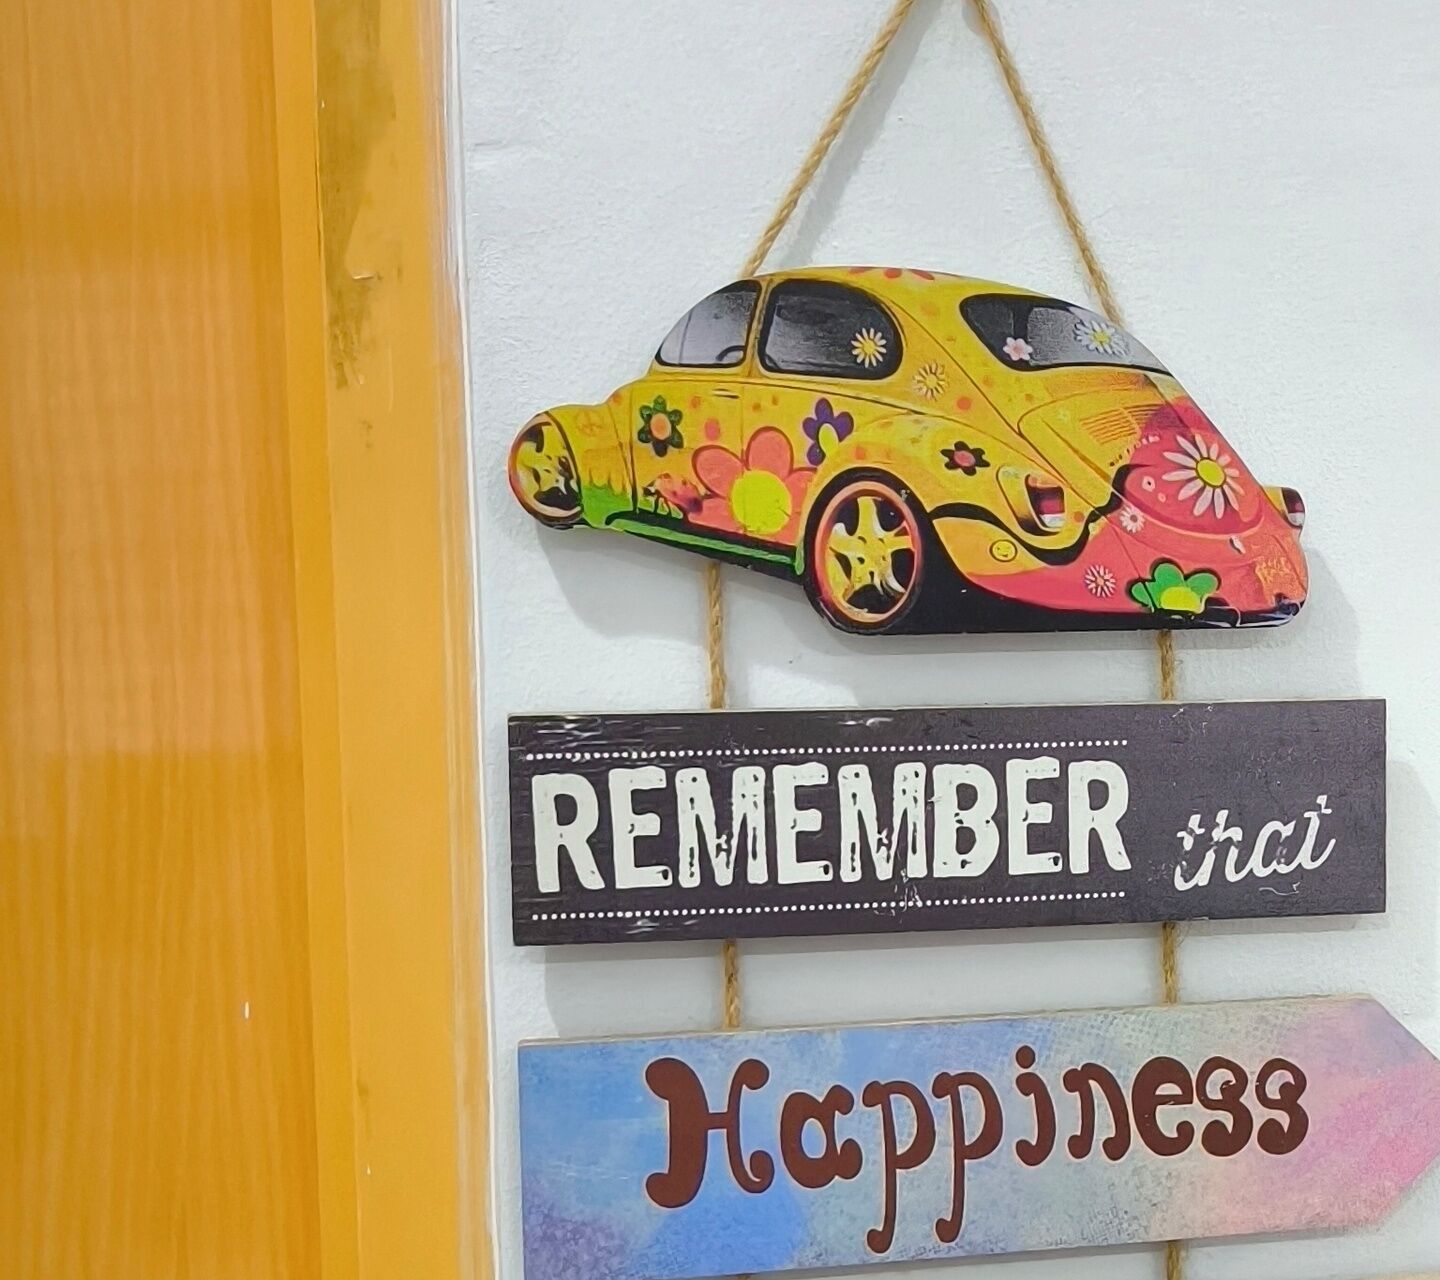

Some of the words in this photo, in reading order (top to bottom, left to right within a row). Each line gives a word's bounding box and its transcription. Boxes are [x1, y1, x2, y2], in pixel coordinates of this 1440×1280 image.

[530, 755, 1133, 894] REMEMBER
[1173, 794, 1338, 893] that
[644, 1045, 1309, 1255] Happiness
